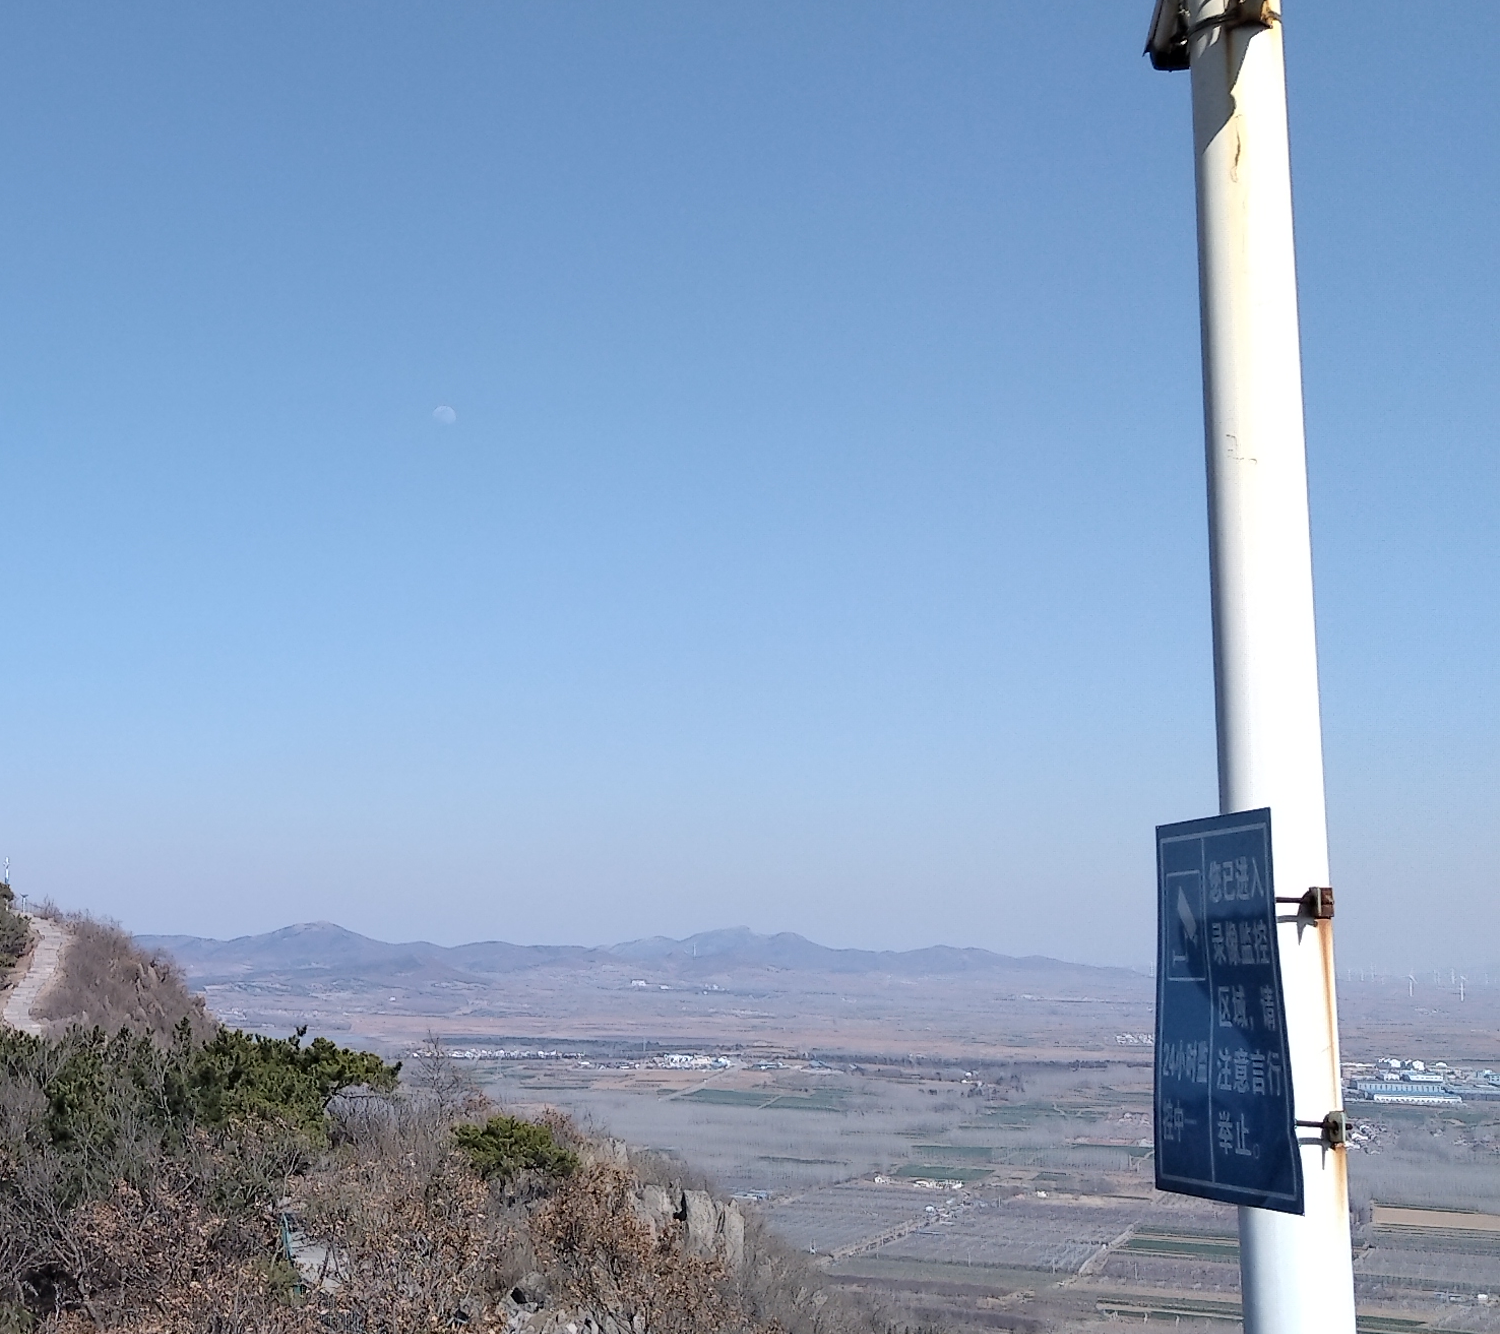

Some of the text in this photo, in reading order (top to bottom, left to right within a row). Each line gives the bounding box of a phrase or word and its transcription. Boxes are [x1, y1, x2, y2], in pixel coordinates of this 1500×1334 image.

[1208, 856, 1264, 904] 您已进入
[1211, 919, 1270, 965] 录像监控
[1162, 1040, 1208, 1083] 24小时监
[1217, 1047, 1282, 1096] 注意言行
